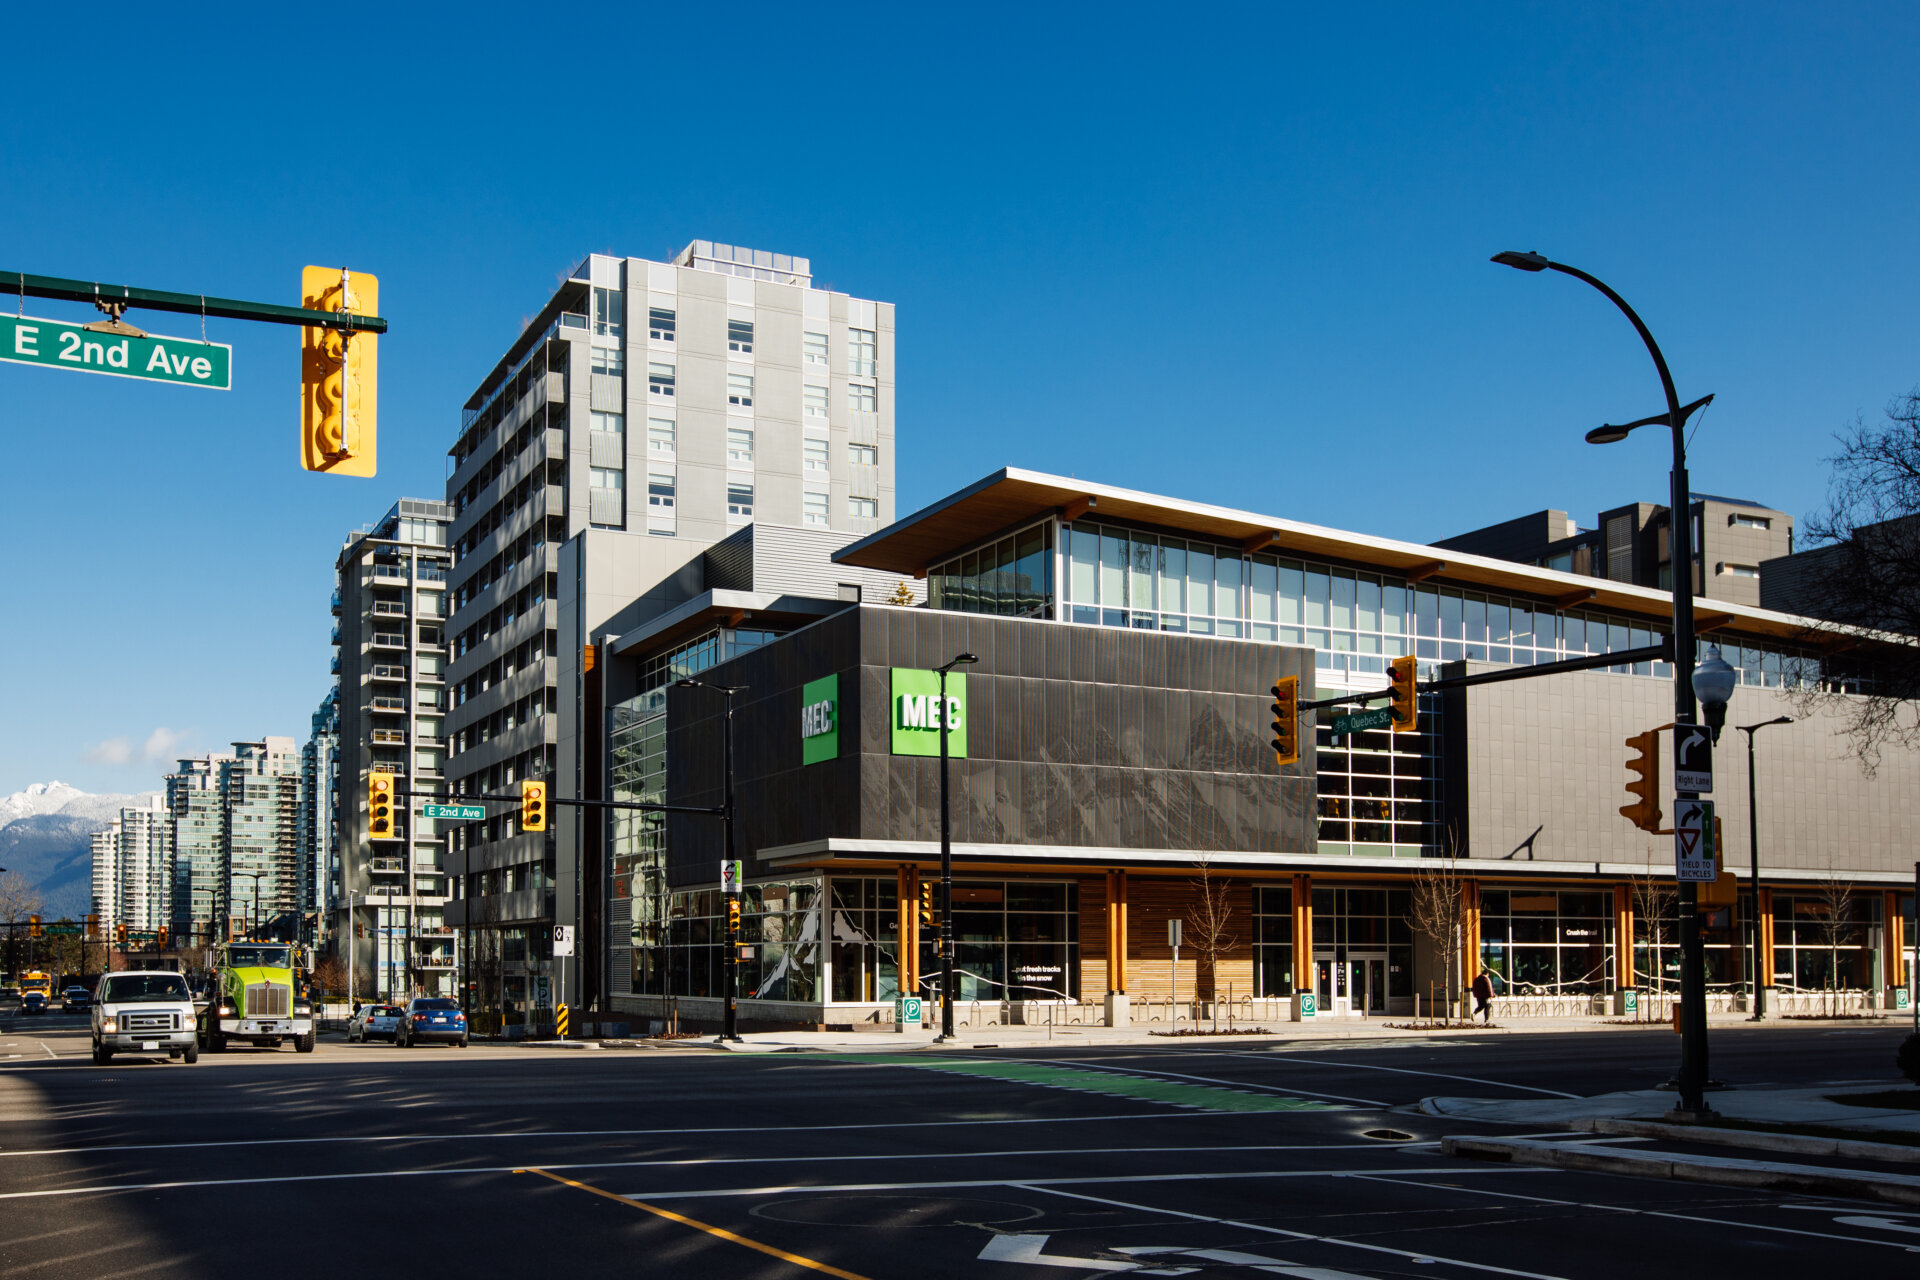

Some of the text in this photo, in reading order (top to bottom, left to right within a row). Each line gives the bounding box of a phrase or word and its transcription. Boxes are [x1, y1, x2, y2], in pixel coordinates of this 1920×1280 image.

[15, 325, 212, 379] E 2nd Ave
[902, 693, 962, 730] MEC
[802, 700, 832, 739] MEC
[1350, 711, 1390, 729] Quebec St.
[1678, 775, 1710, 786] Right Lane
[428, 806, 480, 818] E 2nd Ave
[1681, 861, 1711, 869] YIELD TO
[1681, 870, 1712, 878] BICYCLES
